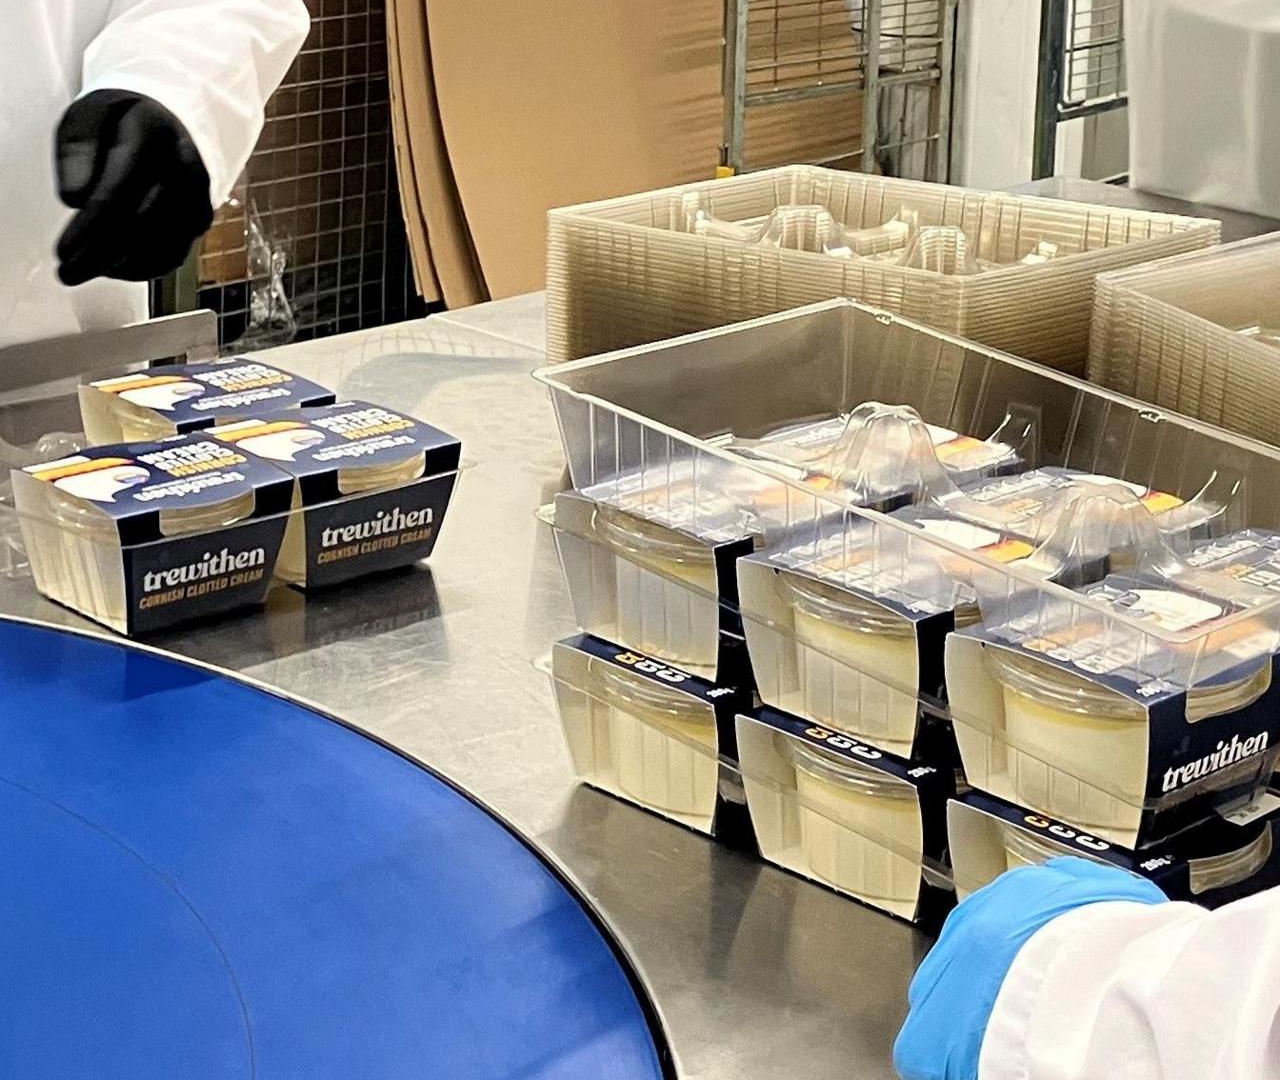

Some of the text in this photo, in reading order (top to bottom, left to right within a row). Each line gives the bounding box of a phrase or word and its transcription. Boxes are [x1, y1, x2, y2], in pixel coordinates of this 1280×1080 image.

[318, 528, 432, 564] CORNISH CLOTTED CREAM
[321, 507, 433, 548] trewithen
[139, 568, 264, 610] CORNISH CLOTTED CREAM
[143, 547, 265, 592] trewithen
[1161, 731, 1269, 793] trewithen
